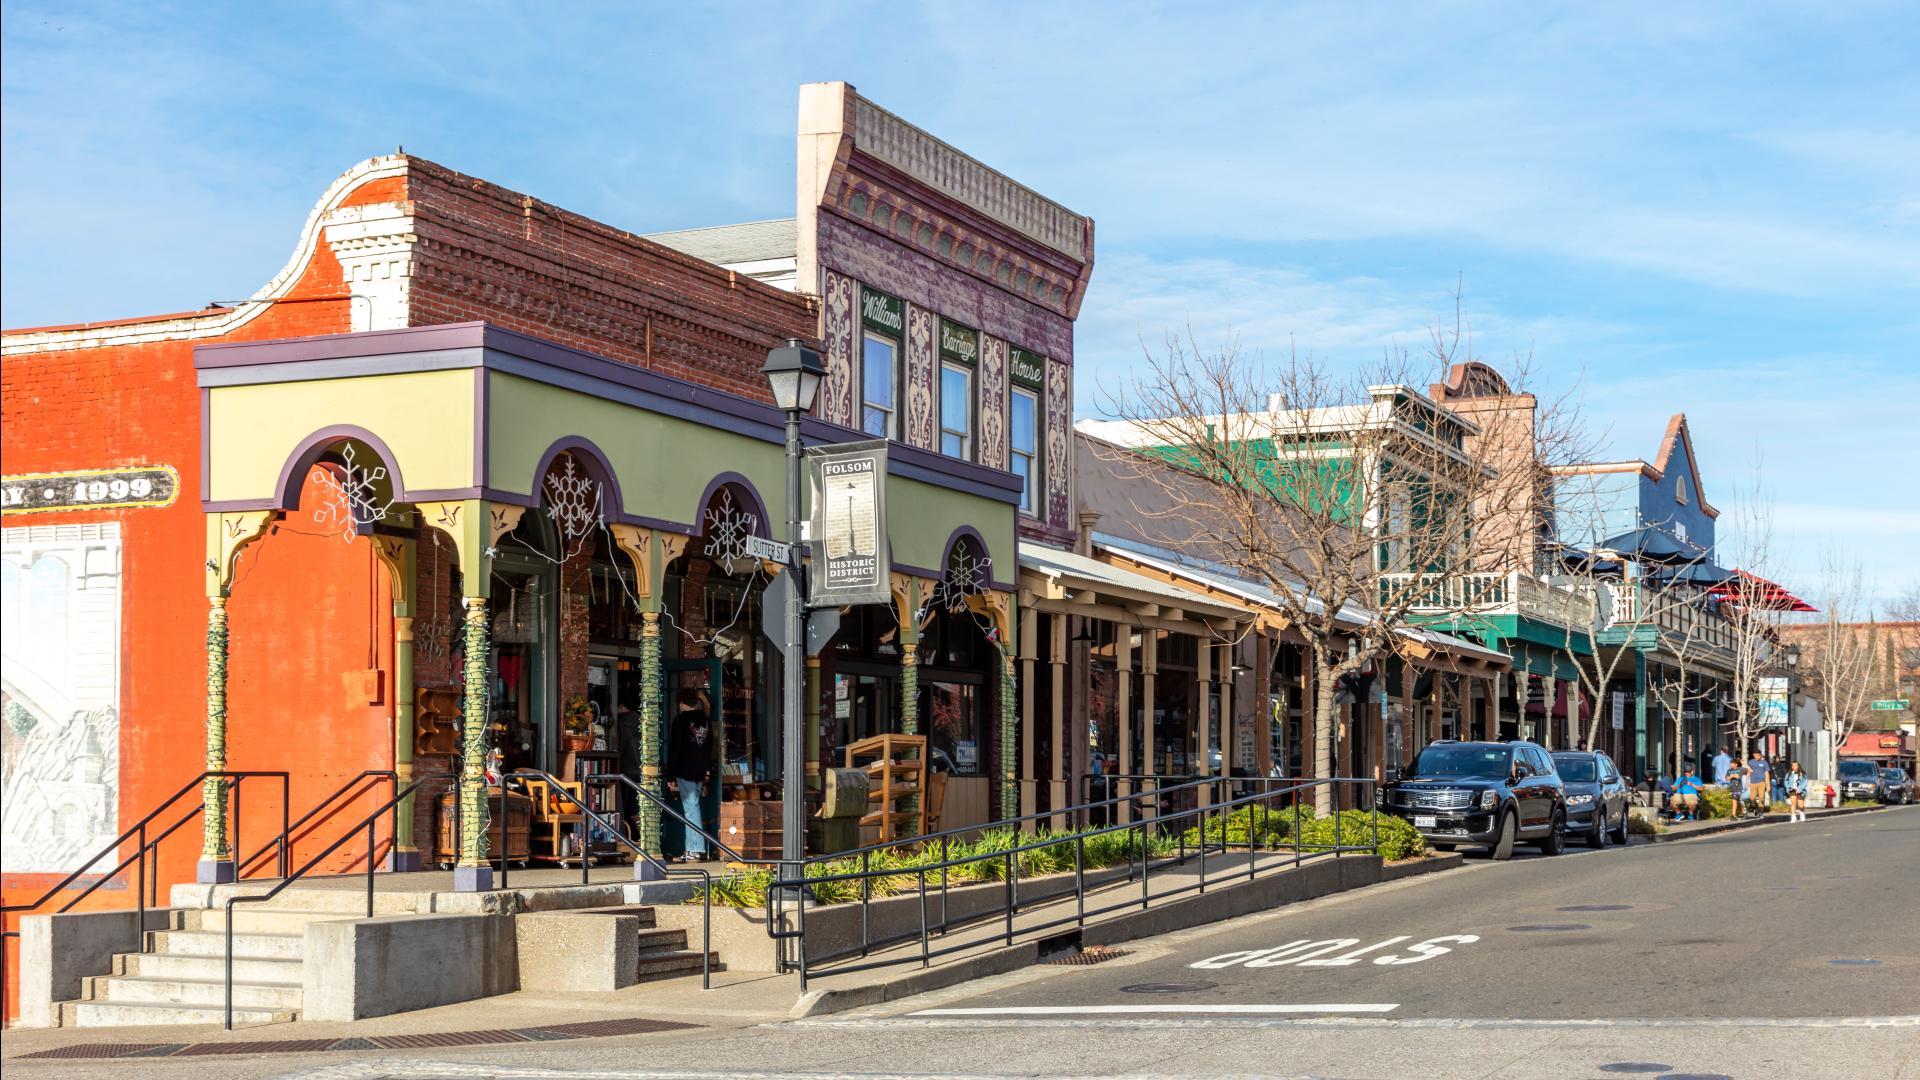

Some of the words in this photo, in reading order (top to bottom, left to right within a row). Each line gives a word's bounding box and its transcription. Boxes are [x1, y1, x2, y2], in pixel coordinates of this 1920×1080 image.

[863, 291, 902, 330] Williams
[943, 326, 977, 362] Carriage
[1010, 350, 1042, 382] House
[826, 461, 872, 475] FOLSOM
[73, 479, 151, 501] 1999
[753, 540, 776, 557] SUTTER
[776, 546, 784, 559] ST
[829, 558, 875, 570] HISTORIC
[829, 567, 875, 578] DISTRICT
[1189, 934, 1481, 969] STOP
